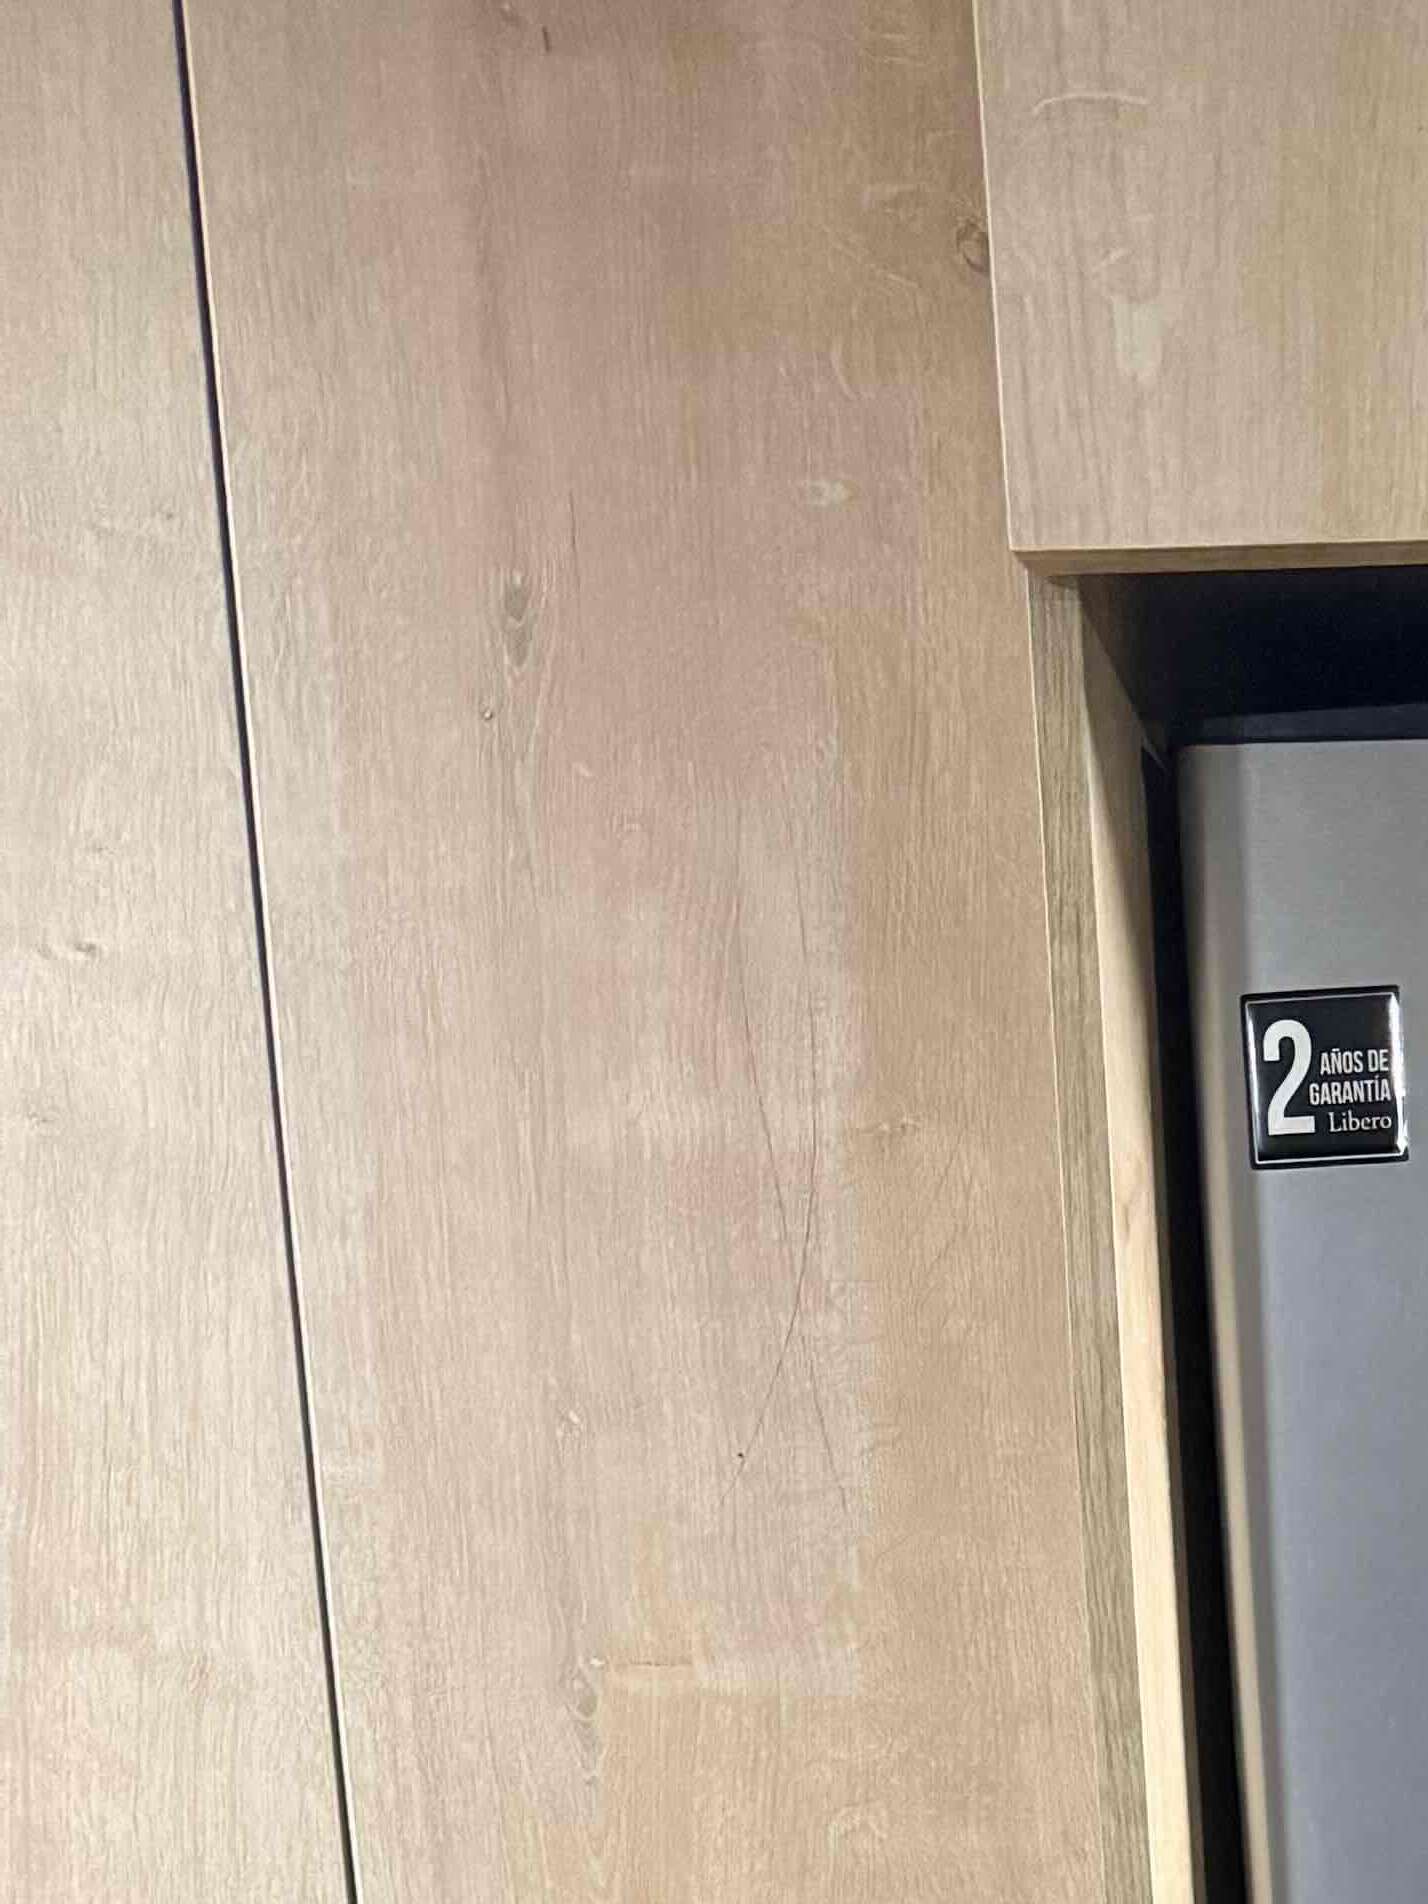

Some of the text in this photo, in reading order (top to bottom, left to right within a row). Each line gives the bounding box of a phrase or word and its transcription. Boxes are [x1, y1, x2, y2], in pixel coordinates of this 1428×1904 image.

[1320, 1048, 1389, 1076] AÑOS DE
[1263, 1019, 1315, 1136] 2
[1309, 1075, 1391, 1106] GARANTÍA
[1328, 1110, 1392, 1133] Libero
